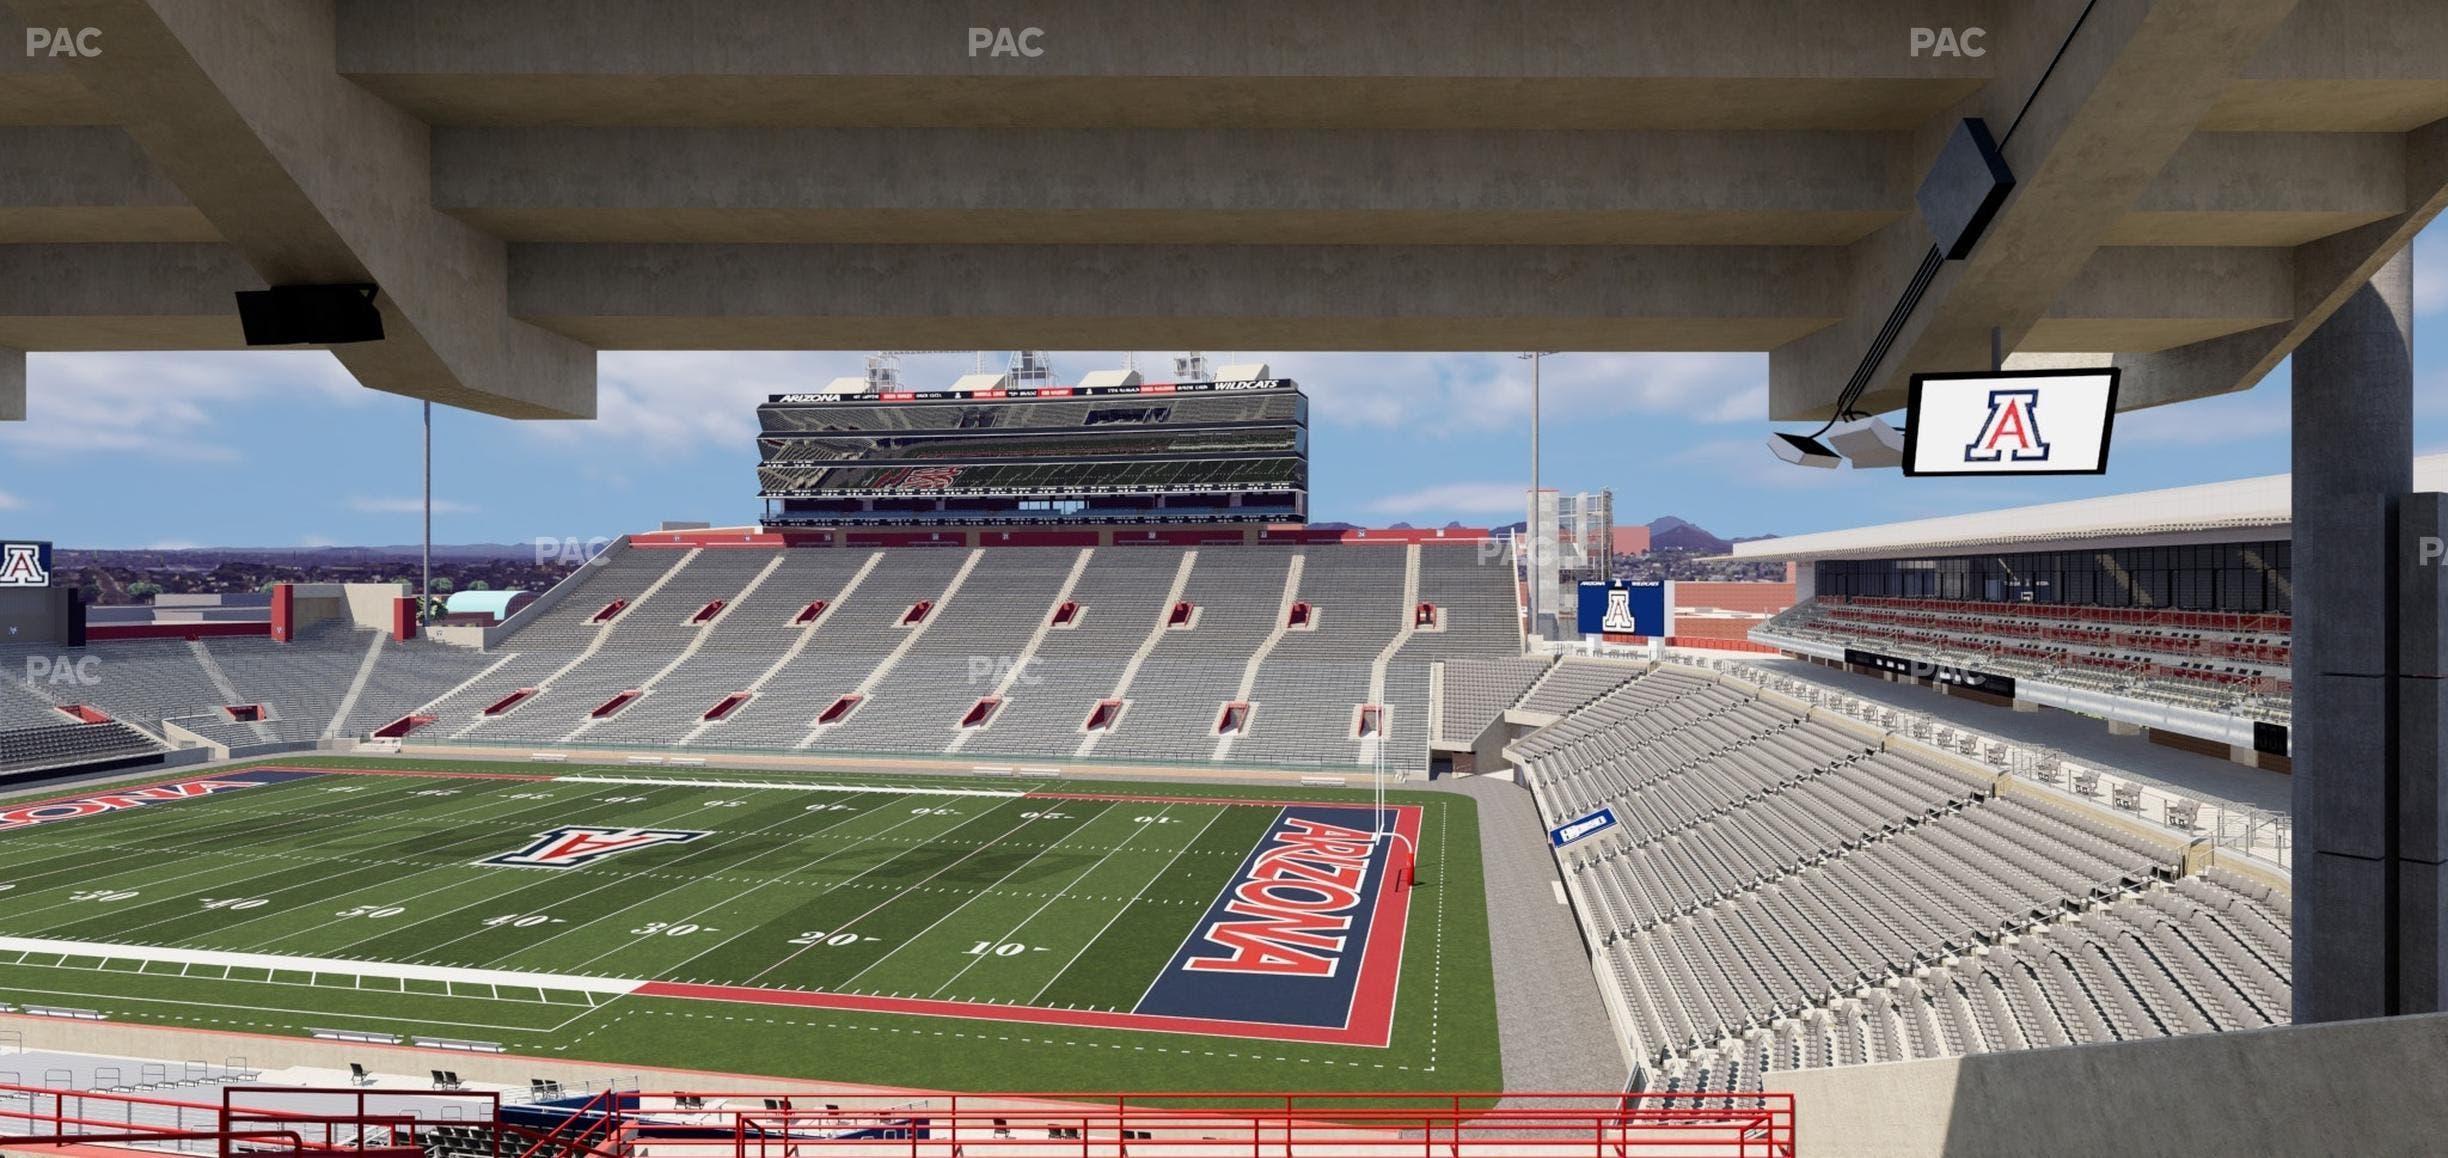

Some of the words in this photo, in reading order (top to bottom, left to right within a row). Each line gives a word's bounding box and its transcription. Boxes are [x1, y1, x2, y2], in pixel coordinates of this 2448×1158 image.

[1214, 380, 1279, 391] WILDCATS
[779, 394, 841, 403] ARIZONA
[1964, 388, 2050, 462] A
[0, 781, 268, 829] ONA
[1182, 817, 1378, 978] ARIZONA
[335, 905, 406, 919] 50
[481, 913, 549, 928] 40
[630, 922, 699, 936] 30
[787, 931, 859, 946] 20
[961, 941, 1026, 957] 10
